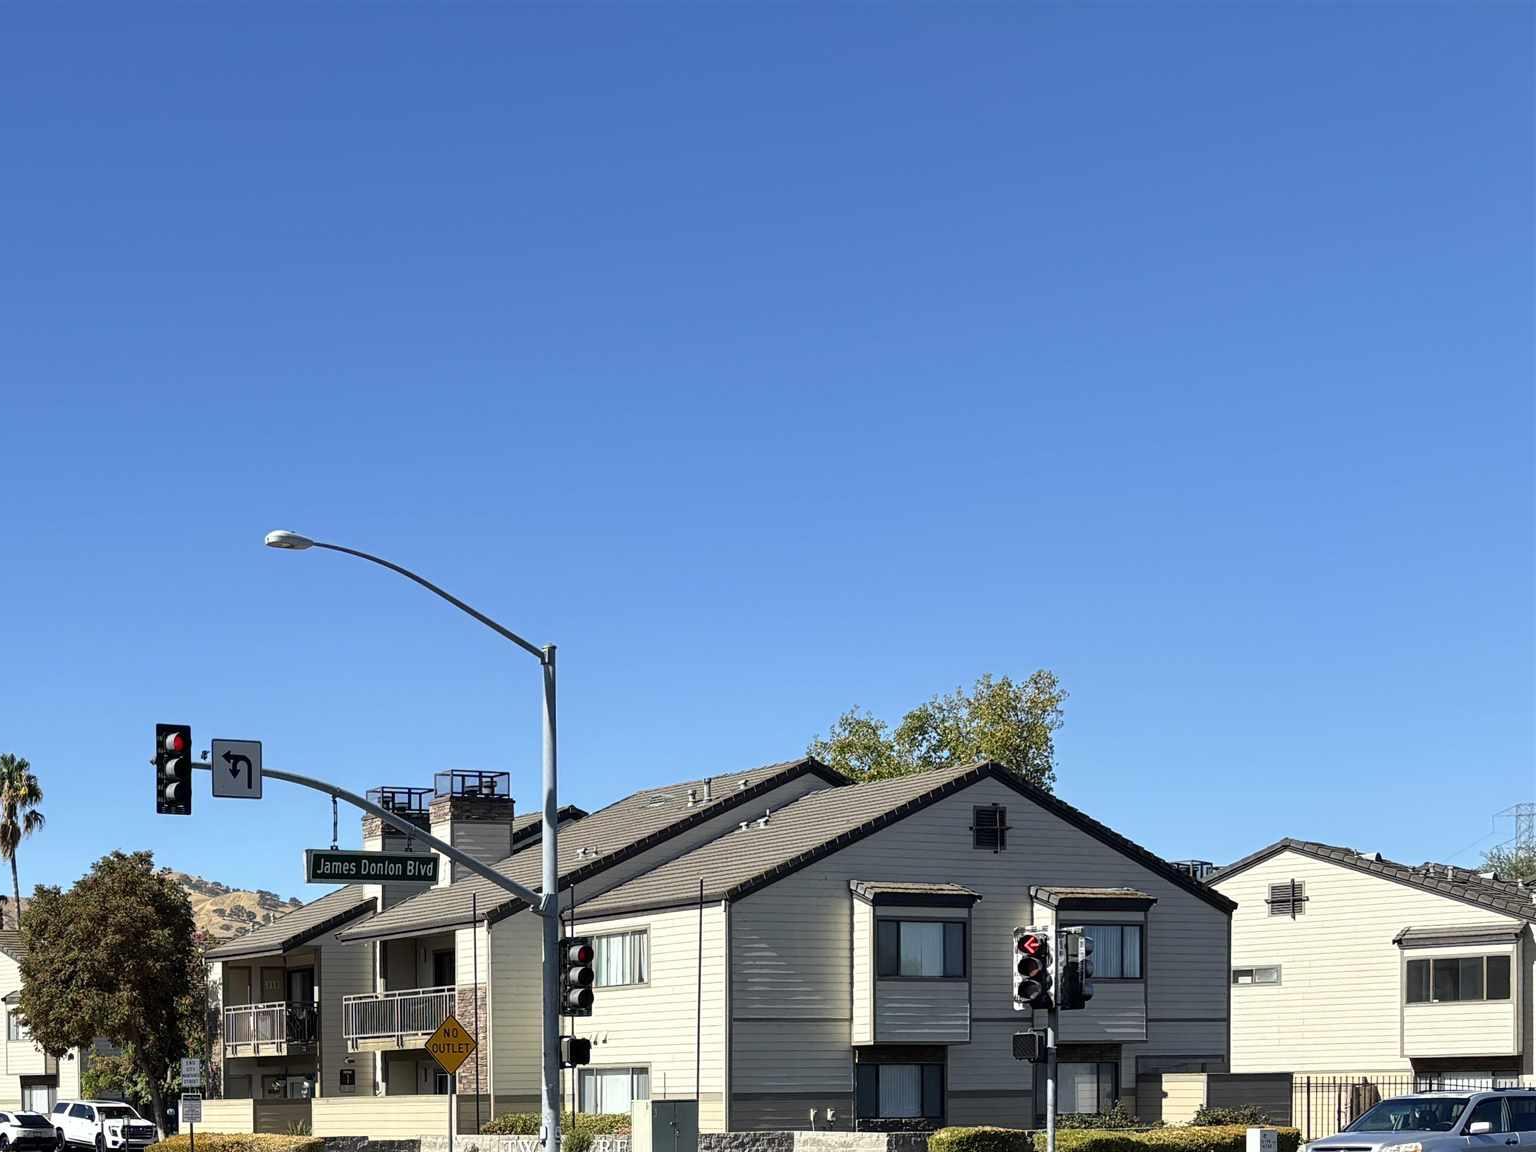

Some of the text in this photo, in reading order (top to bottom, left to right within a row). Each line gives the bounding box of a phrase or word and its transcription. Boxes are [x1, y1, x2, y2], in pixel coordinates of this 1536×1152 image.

[316, 858, 433, 877] James Donlon Blvd
[443, 1028, 458, 1038] NO
[432, 1043, 470, 1053] OUTLET
